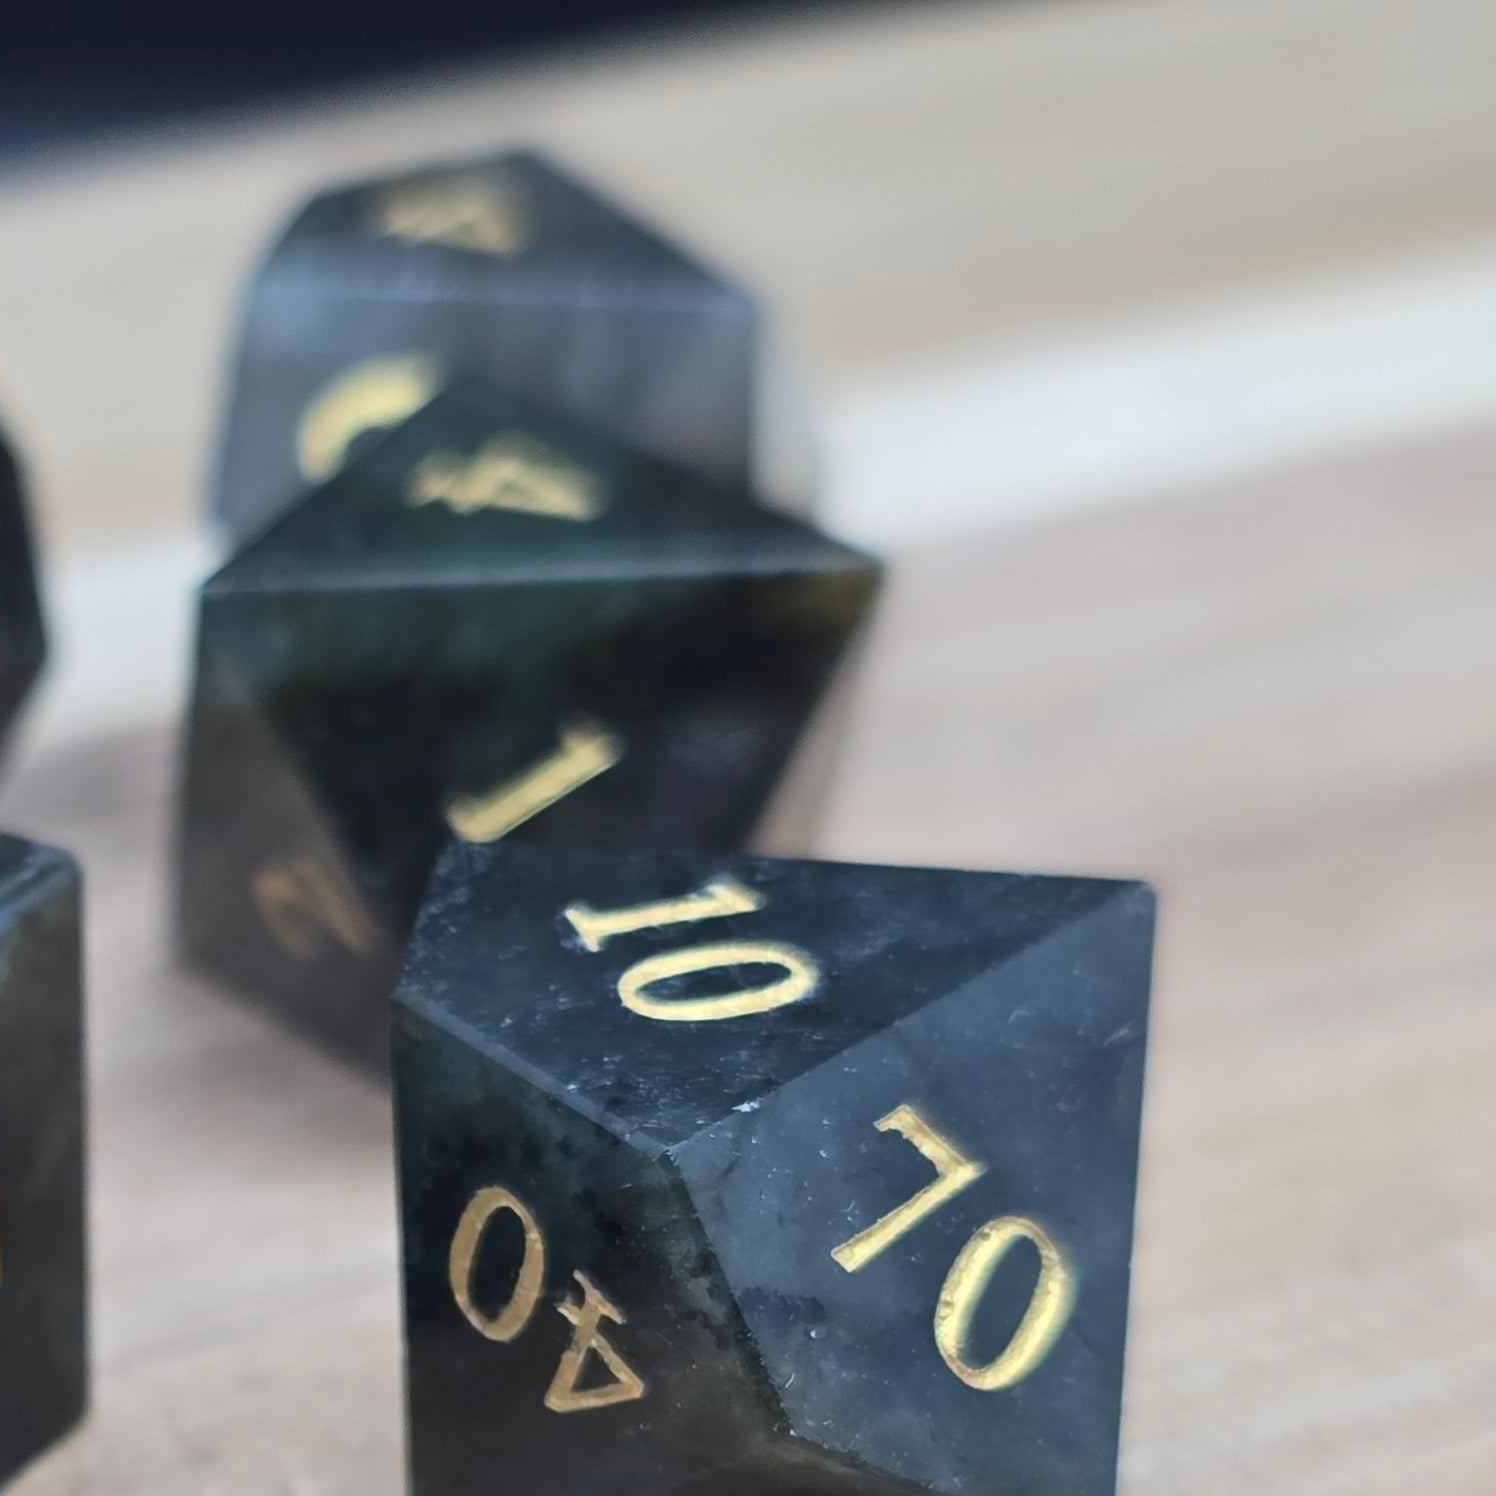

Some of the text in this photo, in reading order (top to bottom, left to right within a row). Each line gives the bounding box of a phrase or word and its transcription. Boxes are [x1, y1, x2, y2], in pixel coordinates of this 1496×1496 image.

[559, 873, 828, 1025] 10
[448, 1185, 646, 1413] 40
[830, 1103, 1074, 1393] 70
